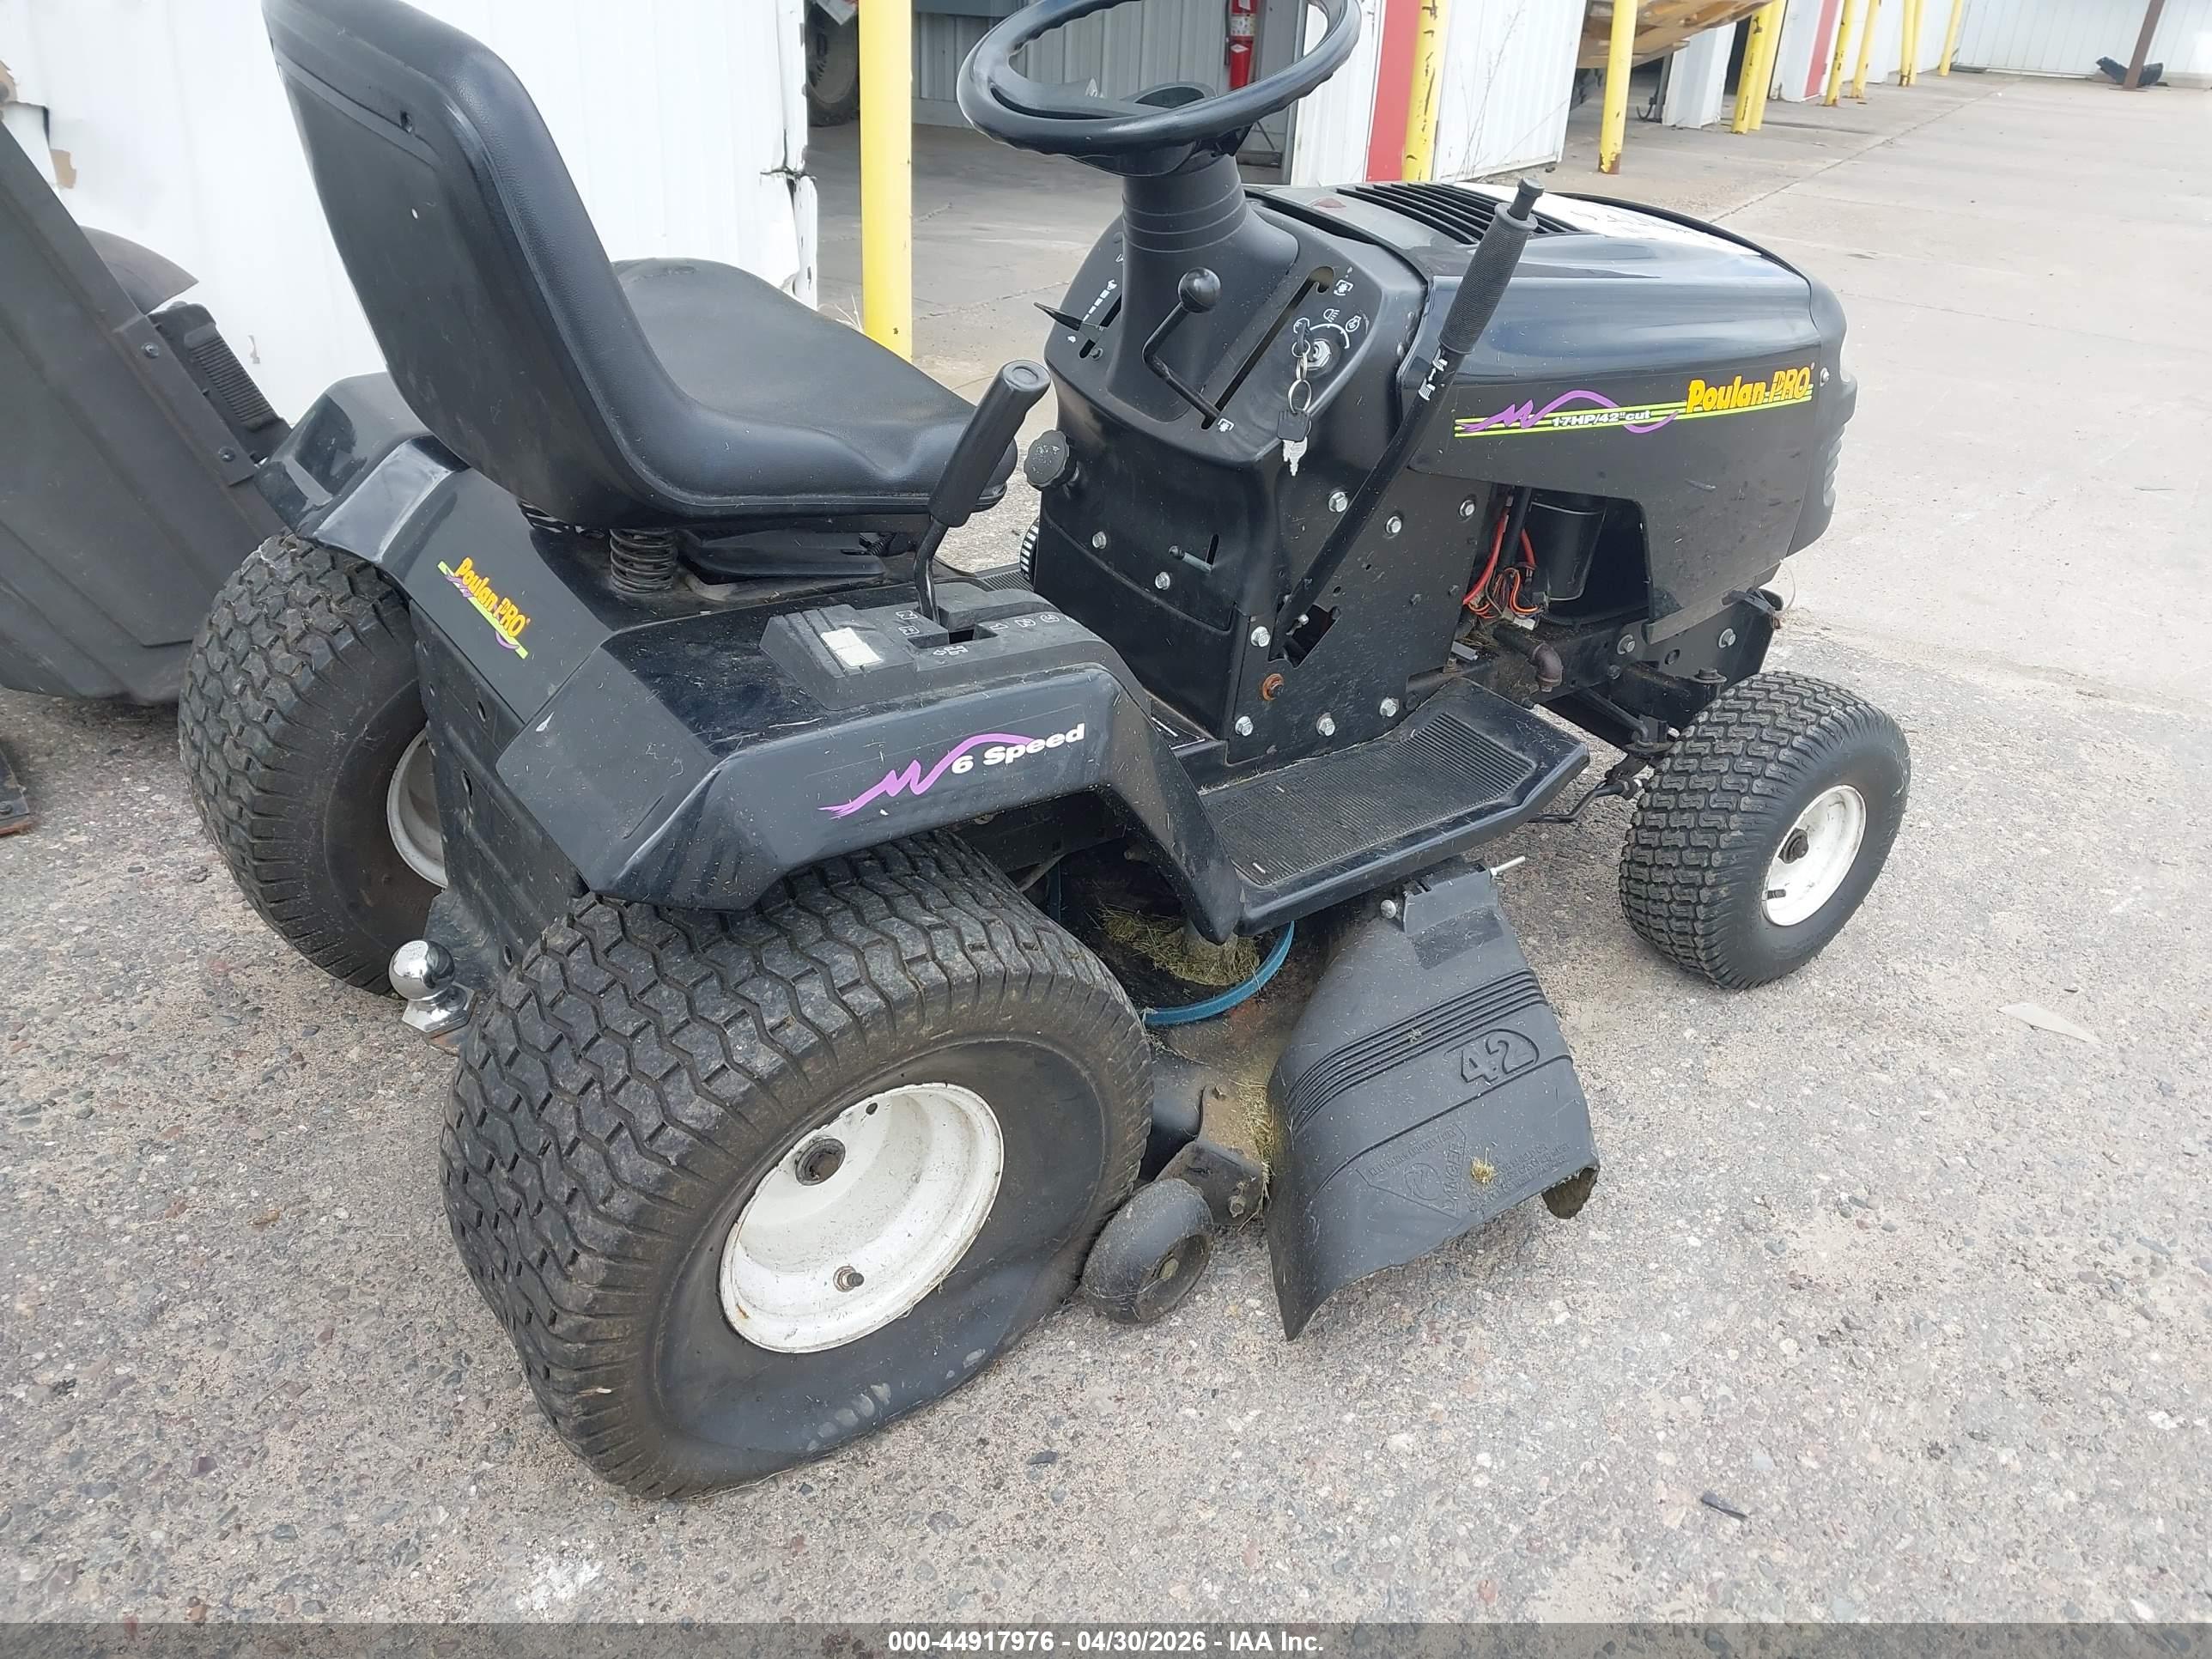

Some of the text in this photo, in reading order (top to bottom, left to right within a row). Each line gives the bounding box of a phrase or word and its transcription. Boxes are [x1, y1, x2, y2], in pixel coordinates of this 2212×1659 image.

[1686, 374, 1766, 413] Poulan
[454, 557, 498, 611] Poulan
[951, 722, 1085, 774] 6 Speed
[1460, 1035, 1534, 1083] 42
